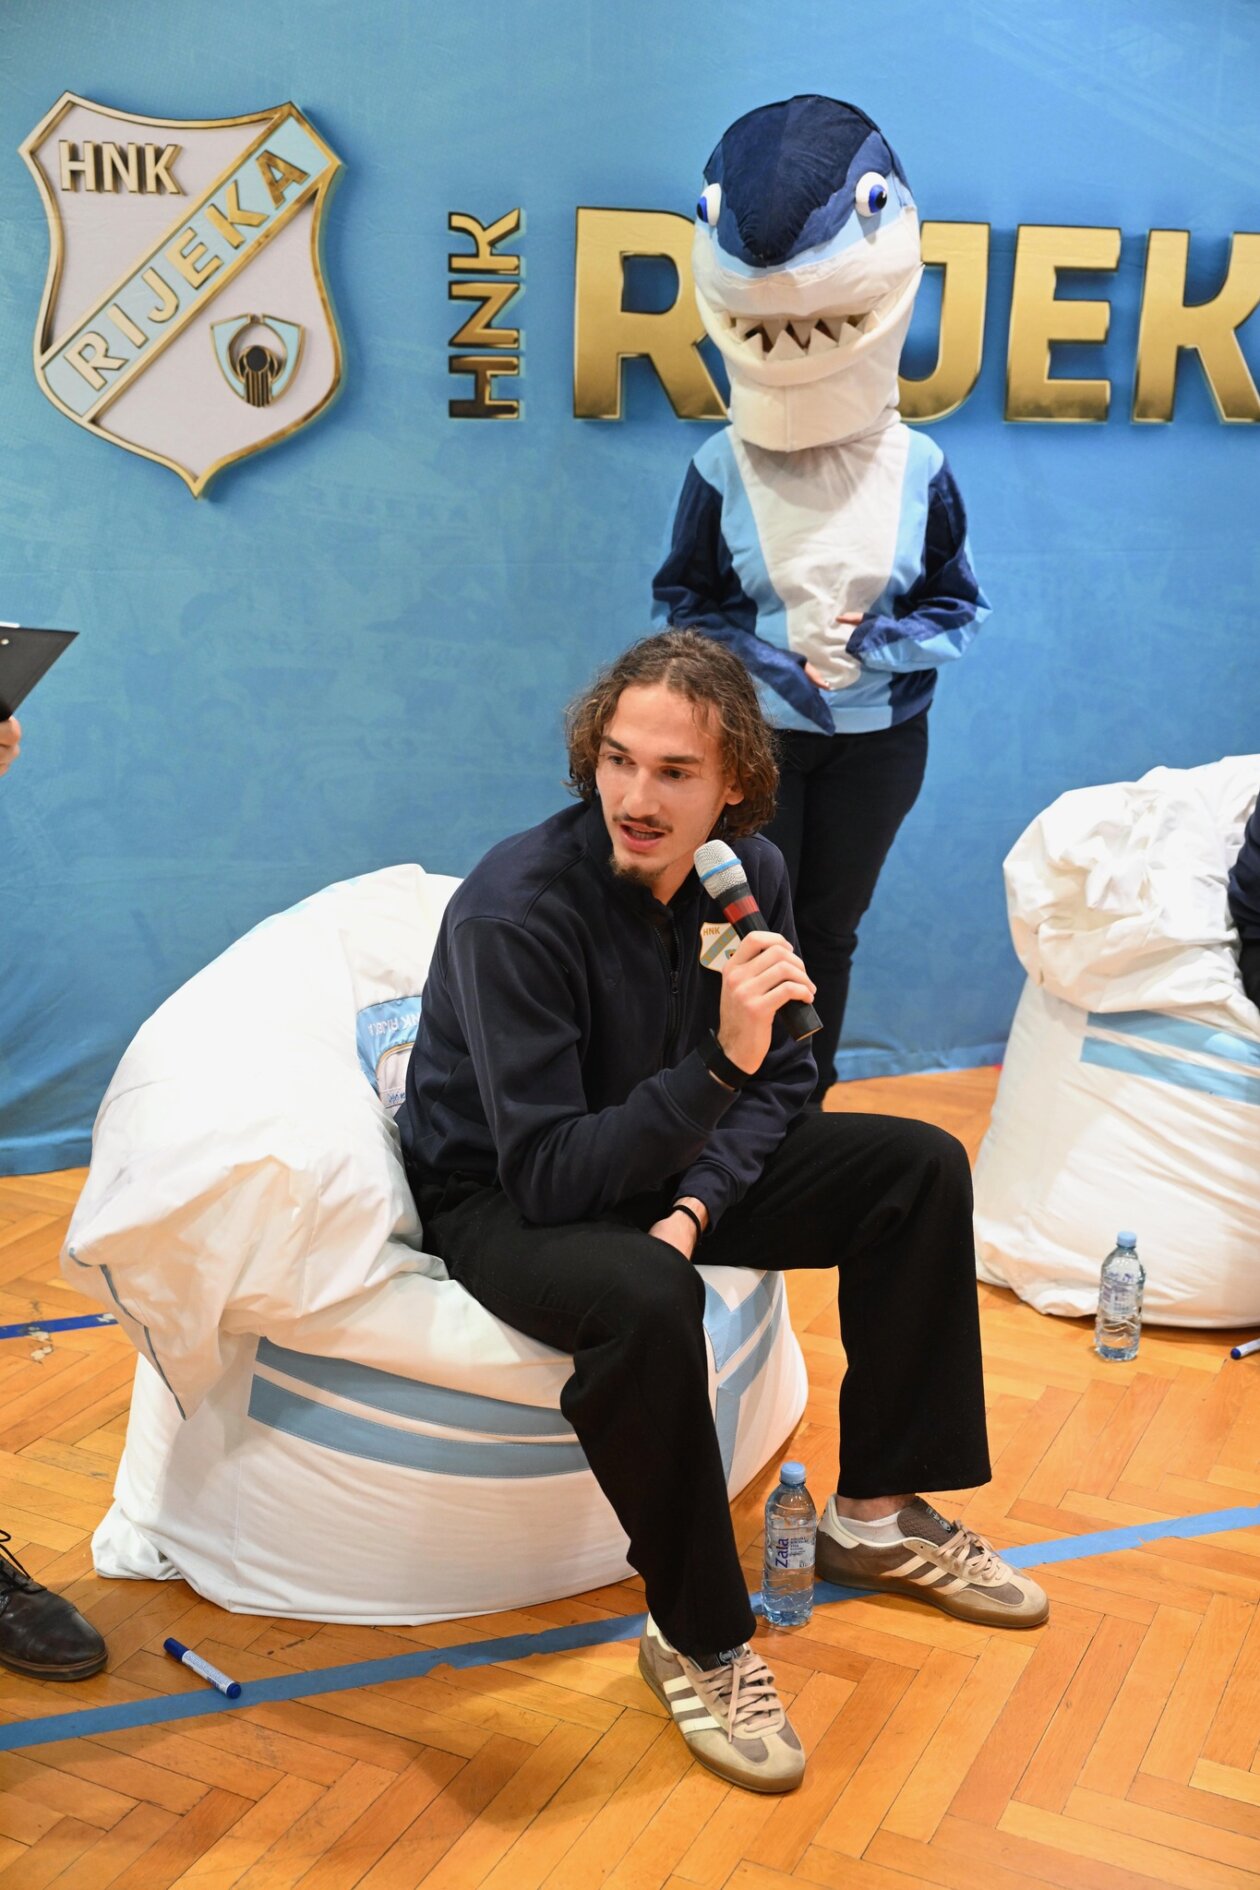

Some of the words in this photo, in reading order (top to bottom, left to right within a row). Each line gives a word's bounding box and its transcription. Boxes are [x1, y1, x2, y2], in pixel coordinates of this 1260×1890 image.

[58, 139, 185, 196] HNK
[63, 148, 311, 392] RIJEKA
[448, 207, 522, 420] HNK
[573, 206, 1260, 424] RJEK
[703, 927, 720, 936] HNK
[776, 1538, 789, 1568] Zala
